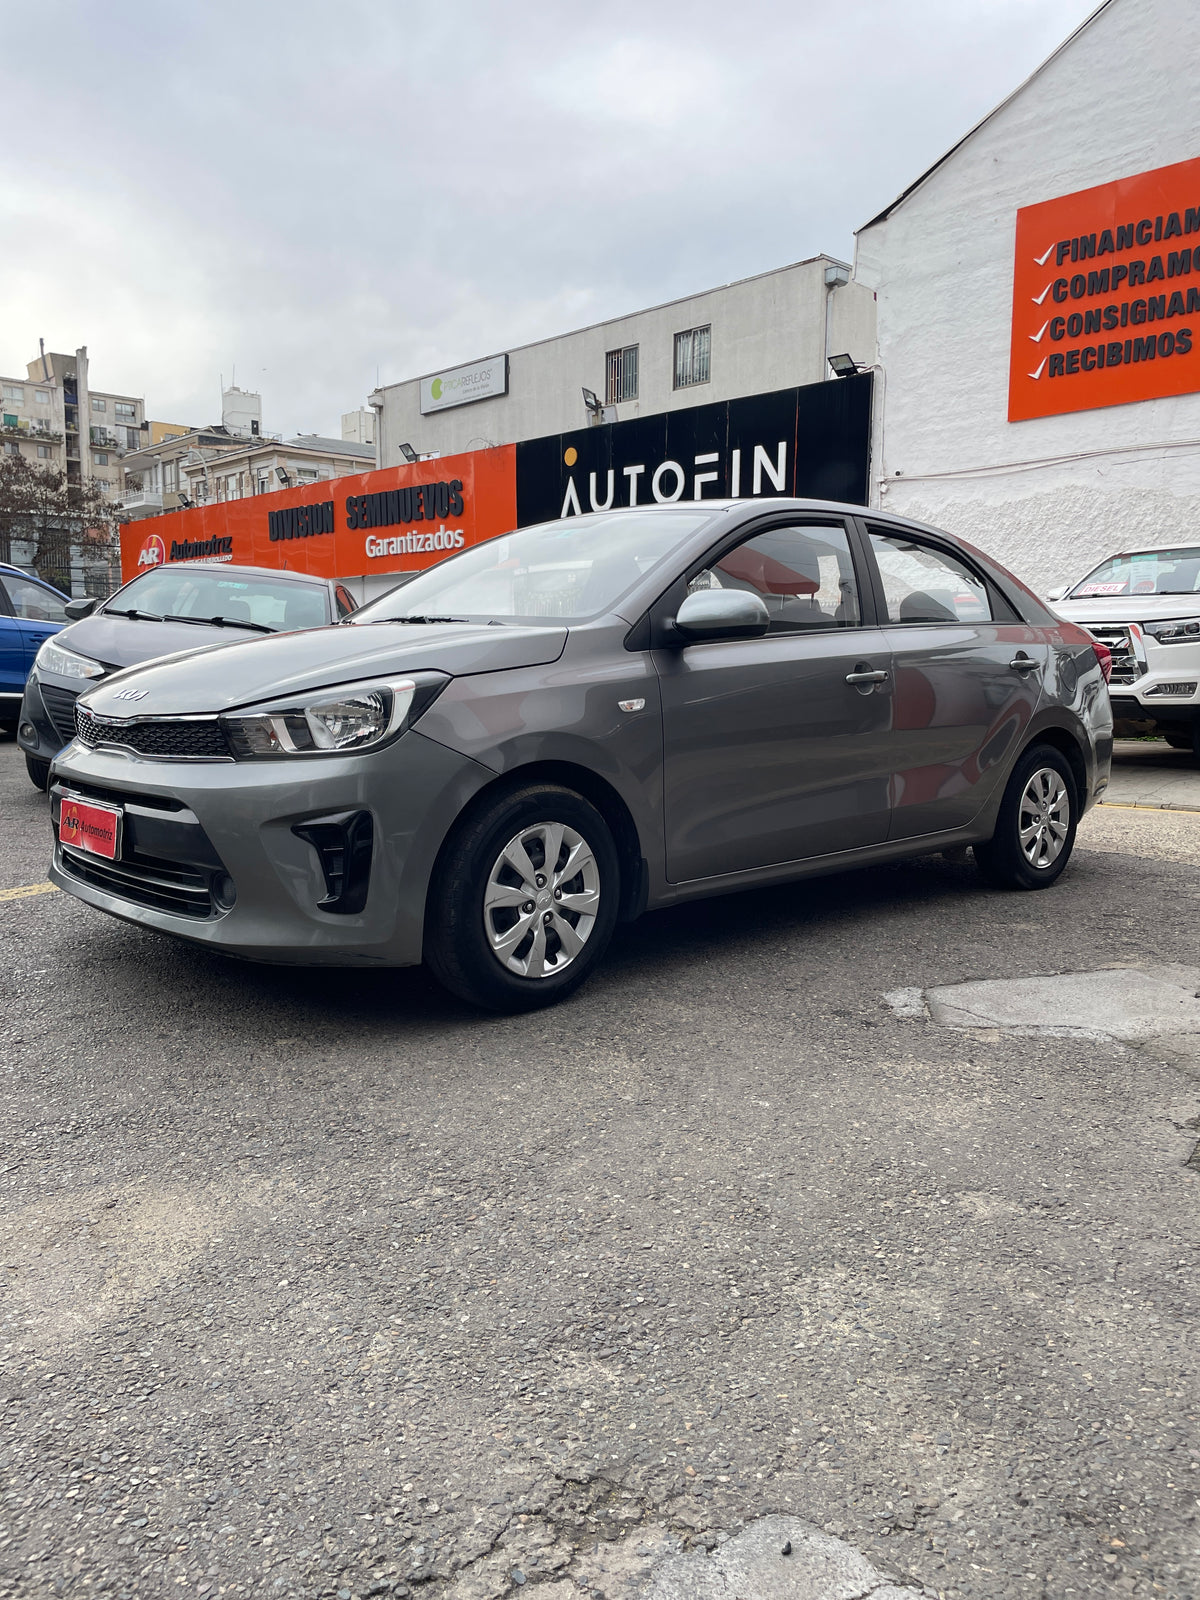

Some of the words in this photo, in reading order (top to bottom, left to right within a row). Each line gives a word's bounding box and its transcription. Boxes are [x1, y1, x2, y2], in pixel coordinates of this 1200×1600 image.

[1048, 328, 1192, 377] RECIBIMOS
[560, 441, 787, 518] AUTOFIN
[268, 500, 334, 541] DIVISION
[346, 479, 464, 529] SEMINUEVOS
[169, 534, 233, 560] Automotriz
[366, 524, 464, 558] Garantizados
[1084, 585, 1119, 593] DIESEL
[81, 820, 113, 840] Automotriz
